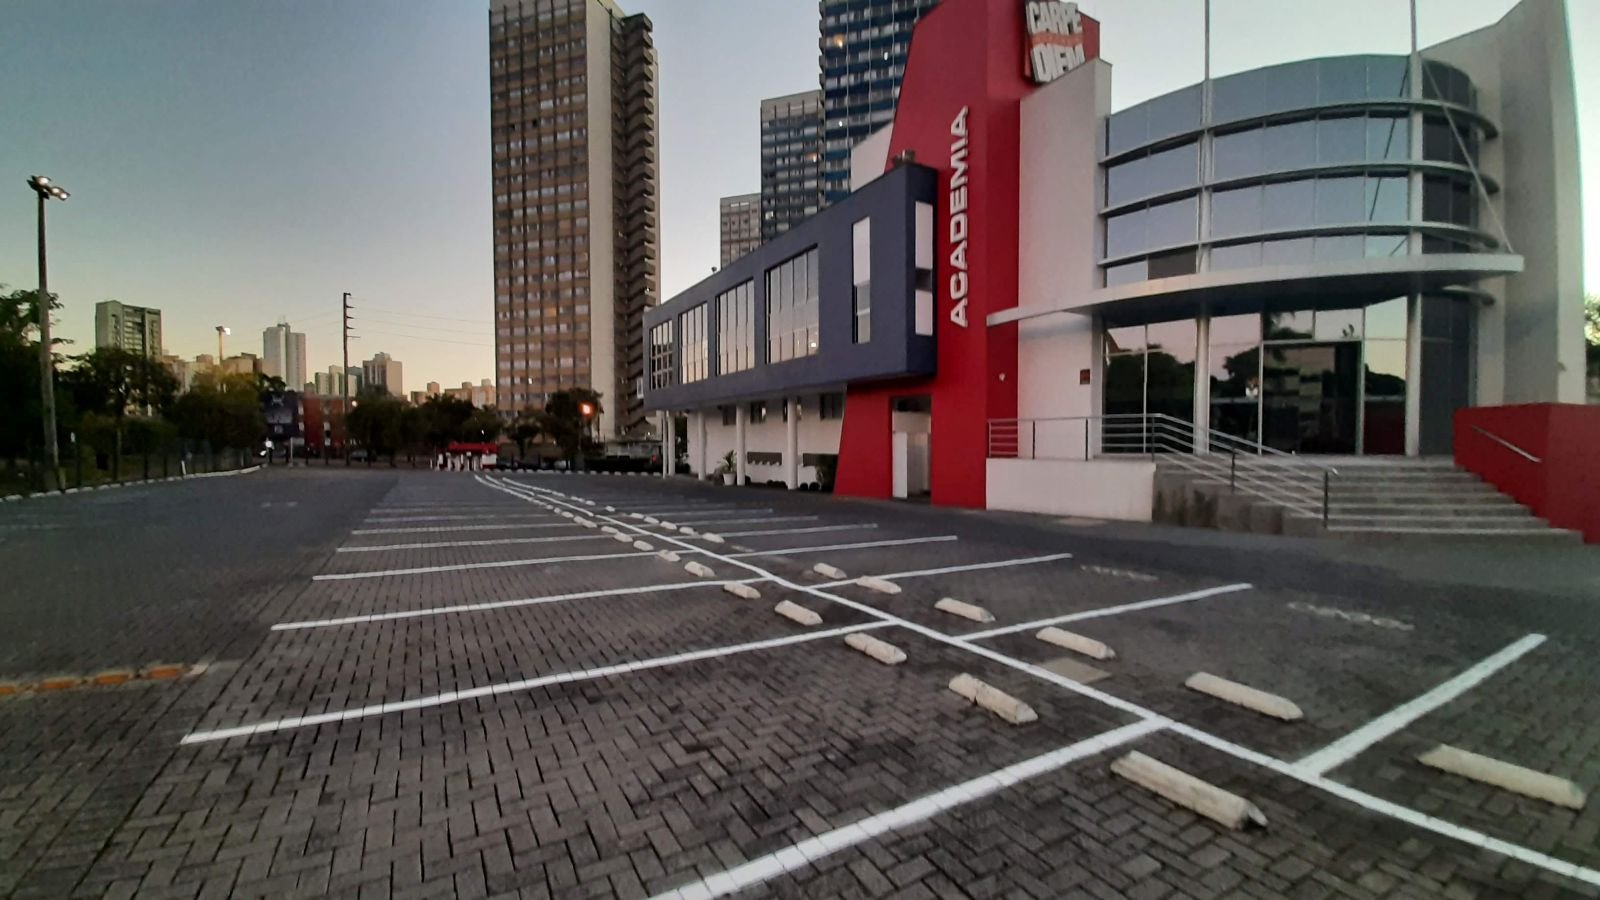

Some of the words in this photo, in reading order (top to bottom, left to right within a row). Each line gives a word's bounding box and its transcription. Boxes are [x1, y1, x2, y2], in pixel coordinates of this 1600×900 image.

[1026, 1, 1082, 35] CARPE
[1031, 43, 1086, 82] DIEM
[950, 105, 968, 328] ACADEMIA
